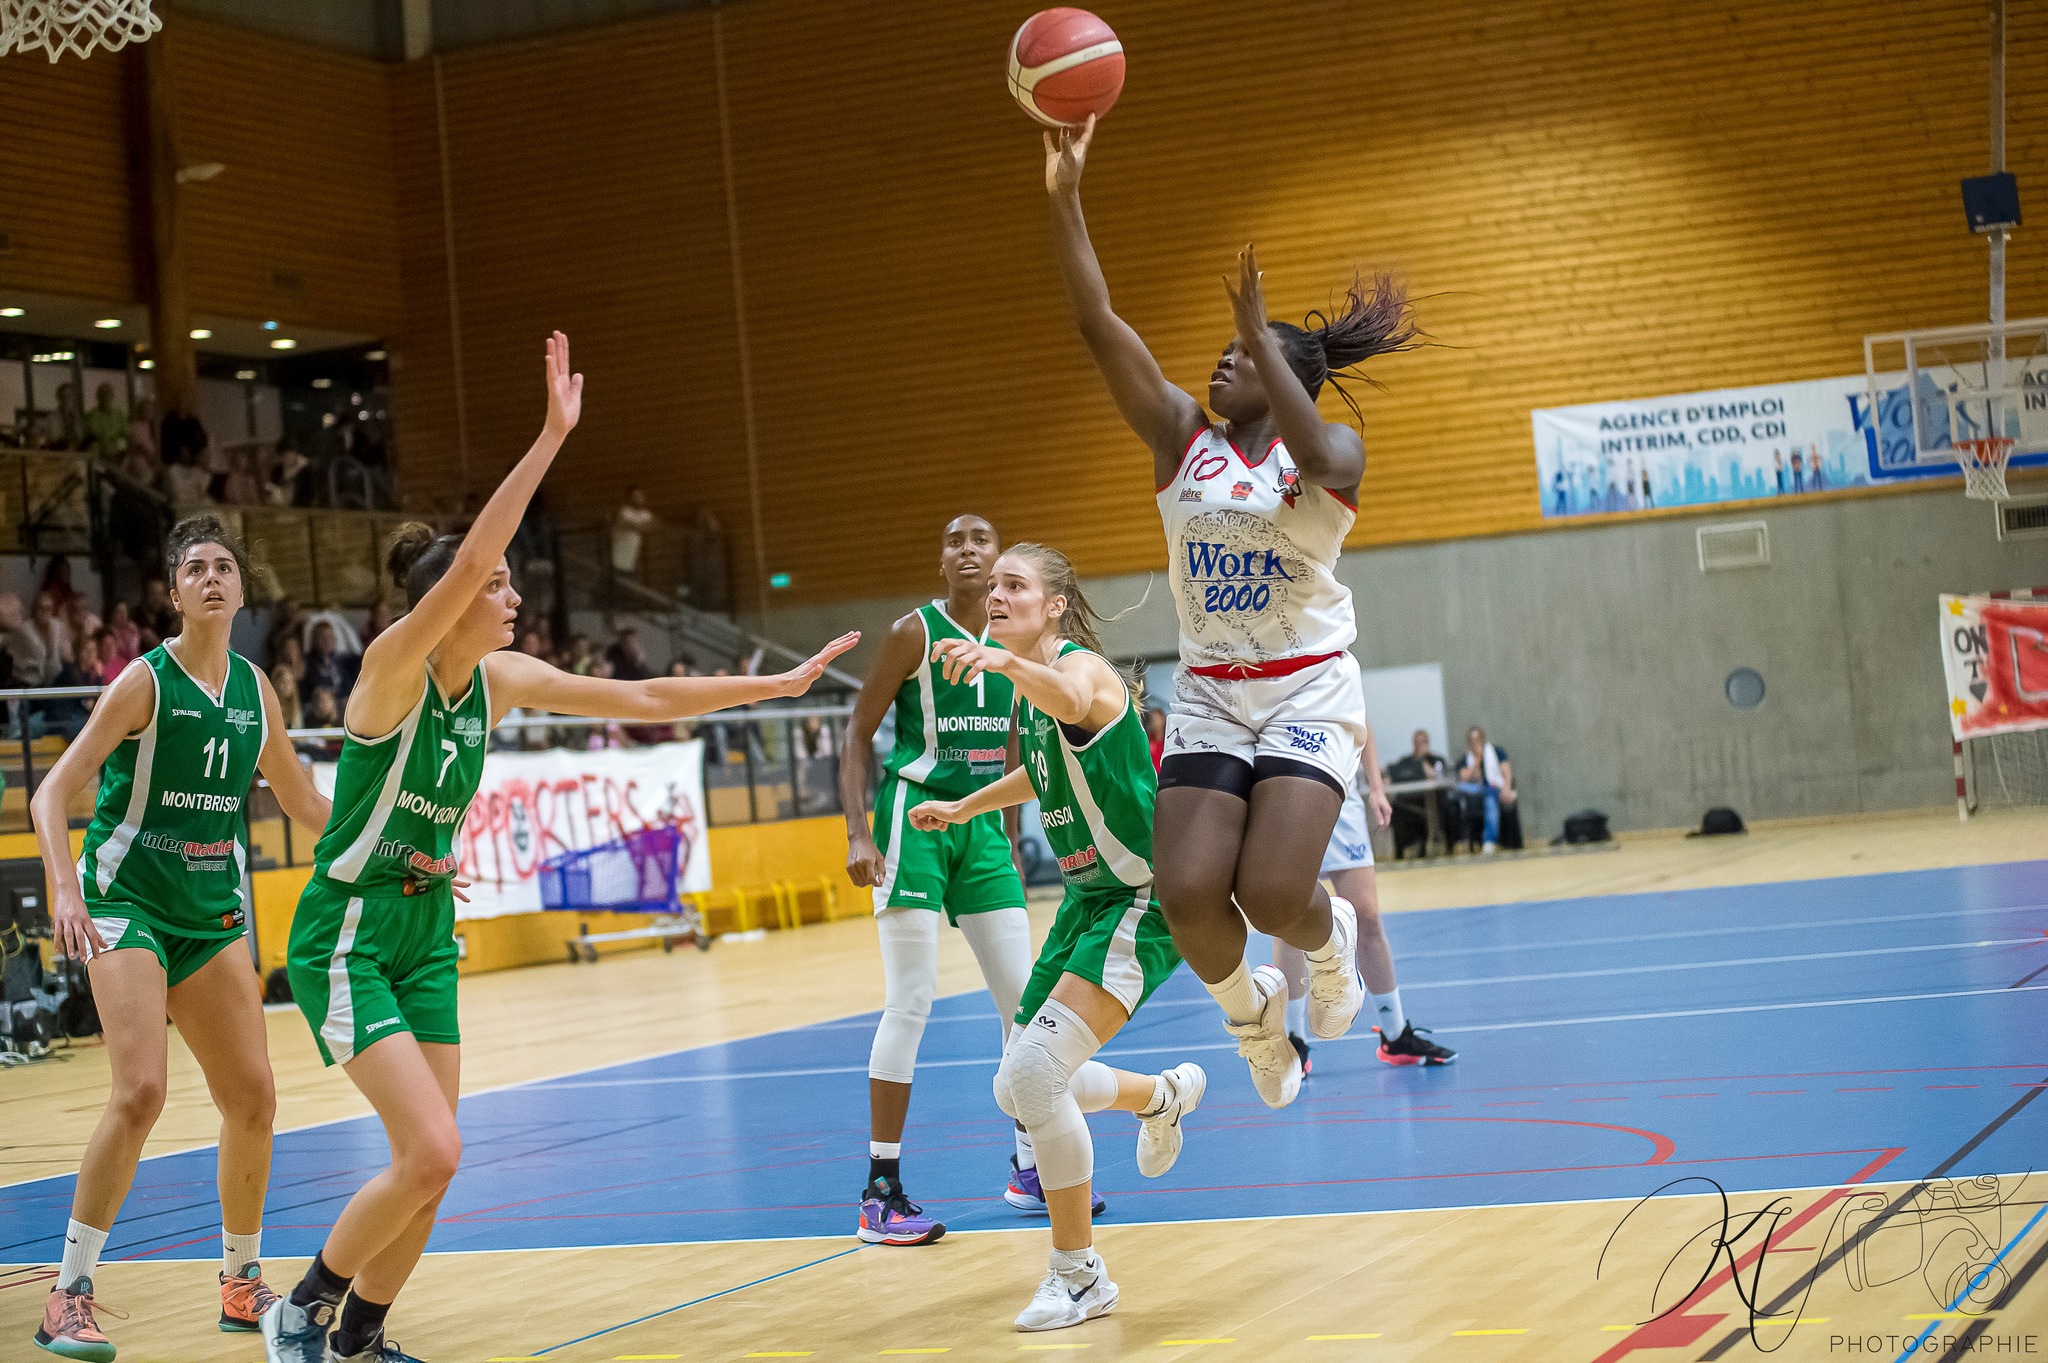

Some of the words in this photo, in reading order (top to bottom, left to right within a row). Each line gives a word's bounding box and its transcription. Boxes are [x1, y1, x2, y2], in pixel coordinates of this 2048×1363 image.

[1599, 408, 1680, 431] AGENCE
[1686, 397, 1785, 424] D'EMPLOI
[1600, 430, 1693, 454] INTERIM,
[1697, 425, 1746, 444] CDD,
[1751, 420, 1787, 439] CDI
[1184, 448, 1228, 481] 10
[1180, 488, 1202, 498] isère
[1186, 541, 1295, 583] Work
[1204, 583, 1270, 613] 2000
[1954, 624, 1989, 655] ON
[1963, 659, 1984, 678] T
[969, 671, 985, 708] 1
[171, 708, 202, 719] SPALDING
[937, 715, 1011, 733] MONTBRISON
[203, 737, 229, 779] 11
[1290, 736, 1321, 753] 2000
[436, 738, 458, 788] 7
[900, 889, 928, 900] SPALDING
